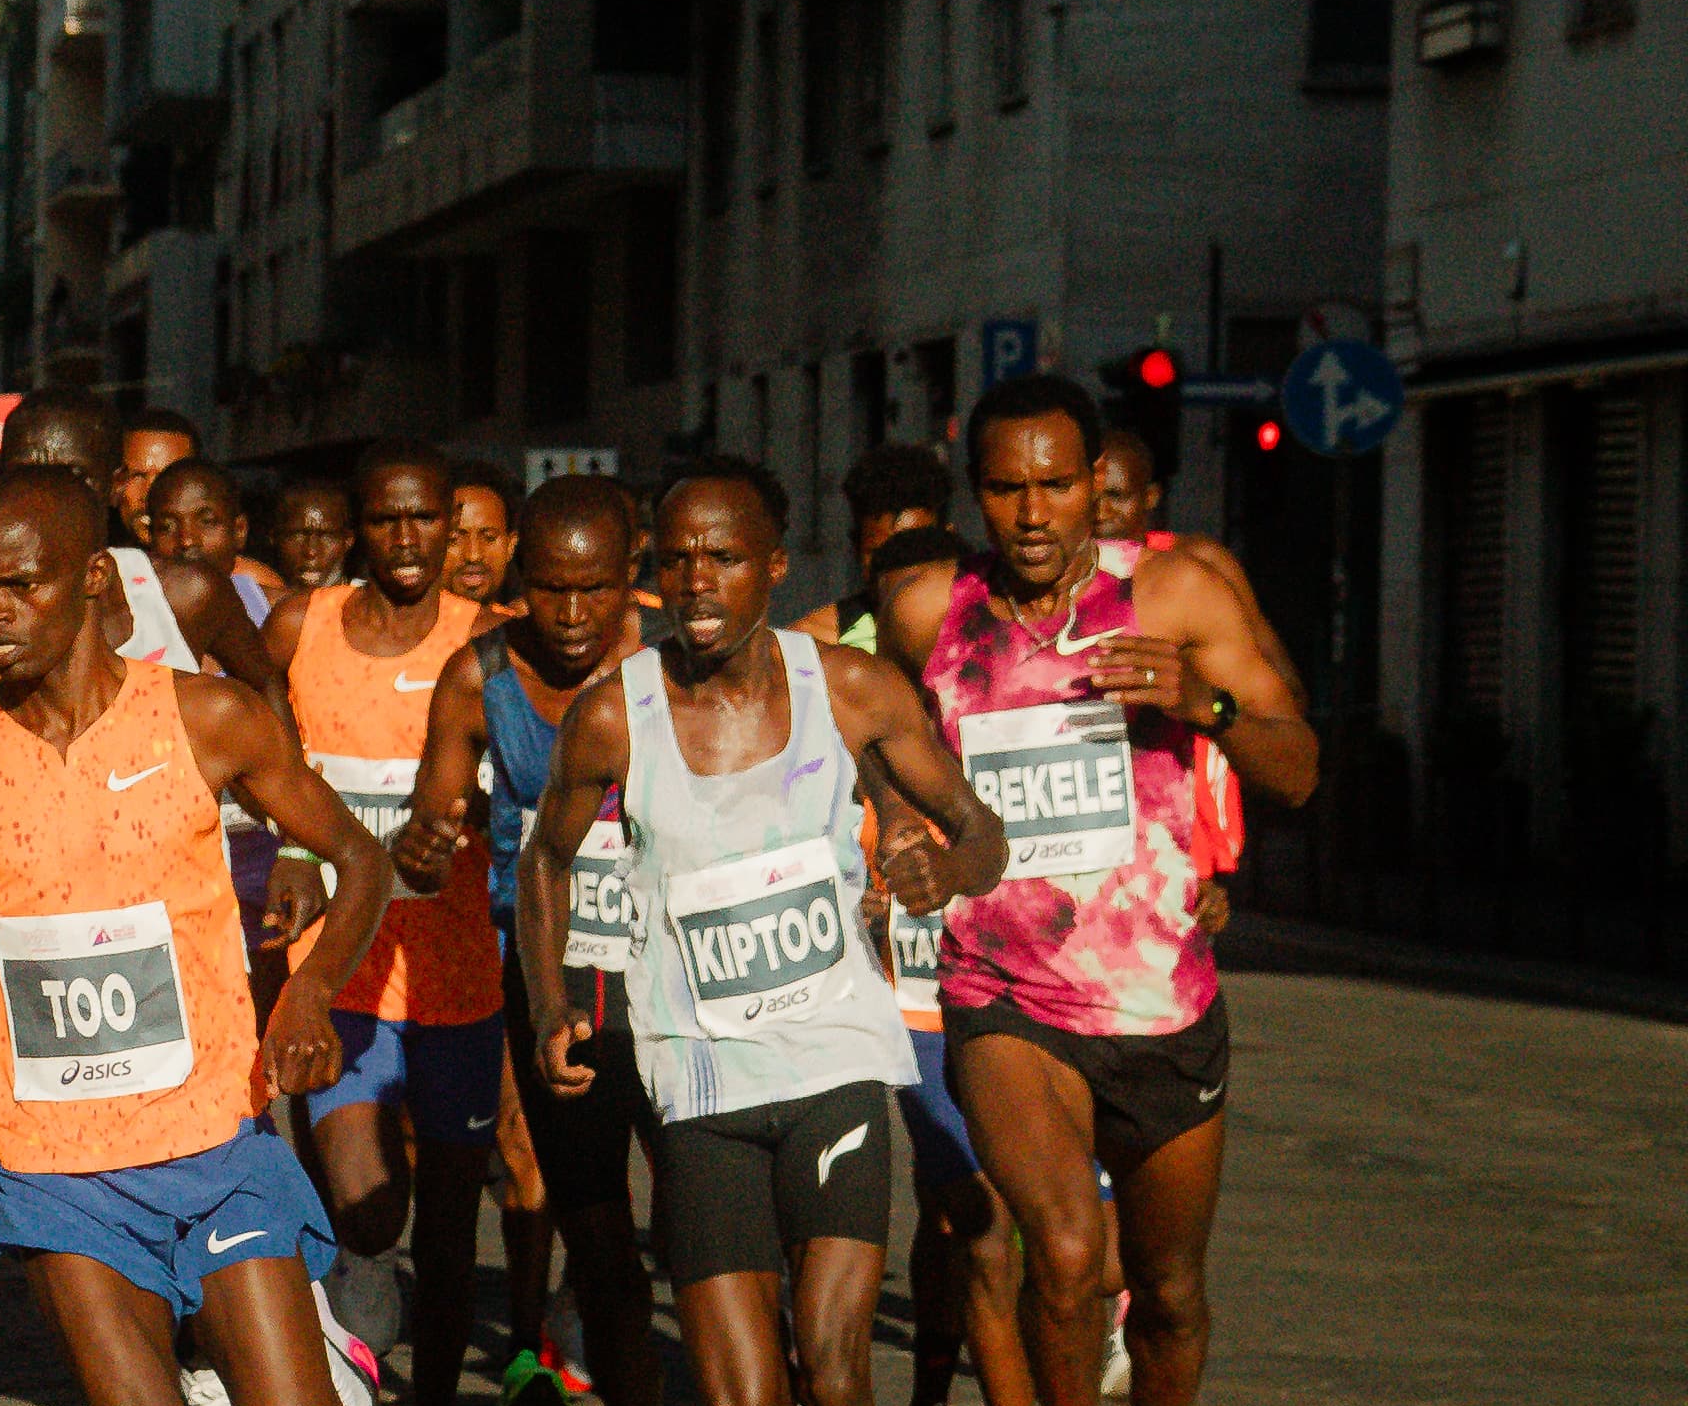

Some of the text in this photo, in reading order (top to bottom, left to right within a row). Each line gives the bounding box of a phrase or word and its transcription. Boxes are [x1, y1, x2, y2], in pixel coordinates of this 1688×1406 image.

[994, 330, 1023, 382] P
[974, 754, 1126, 823] BEKELE
[688, 896, 839, 984] KIPTOO
[40, 972, 137, 1039] TOO
